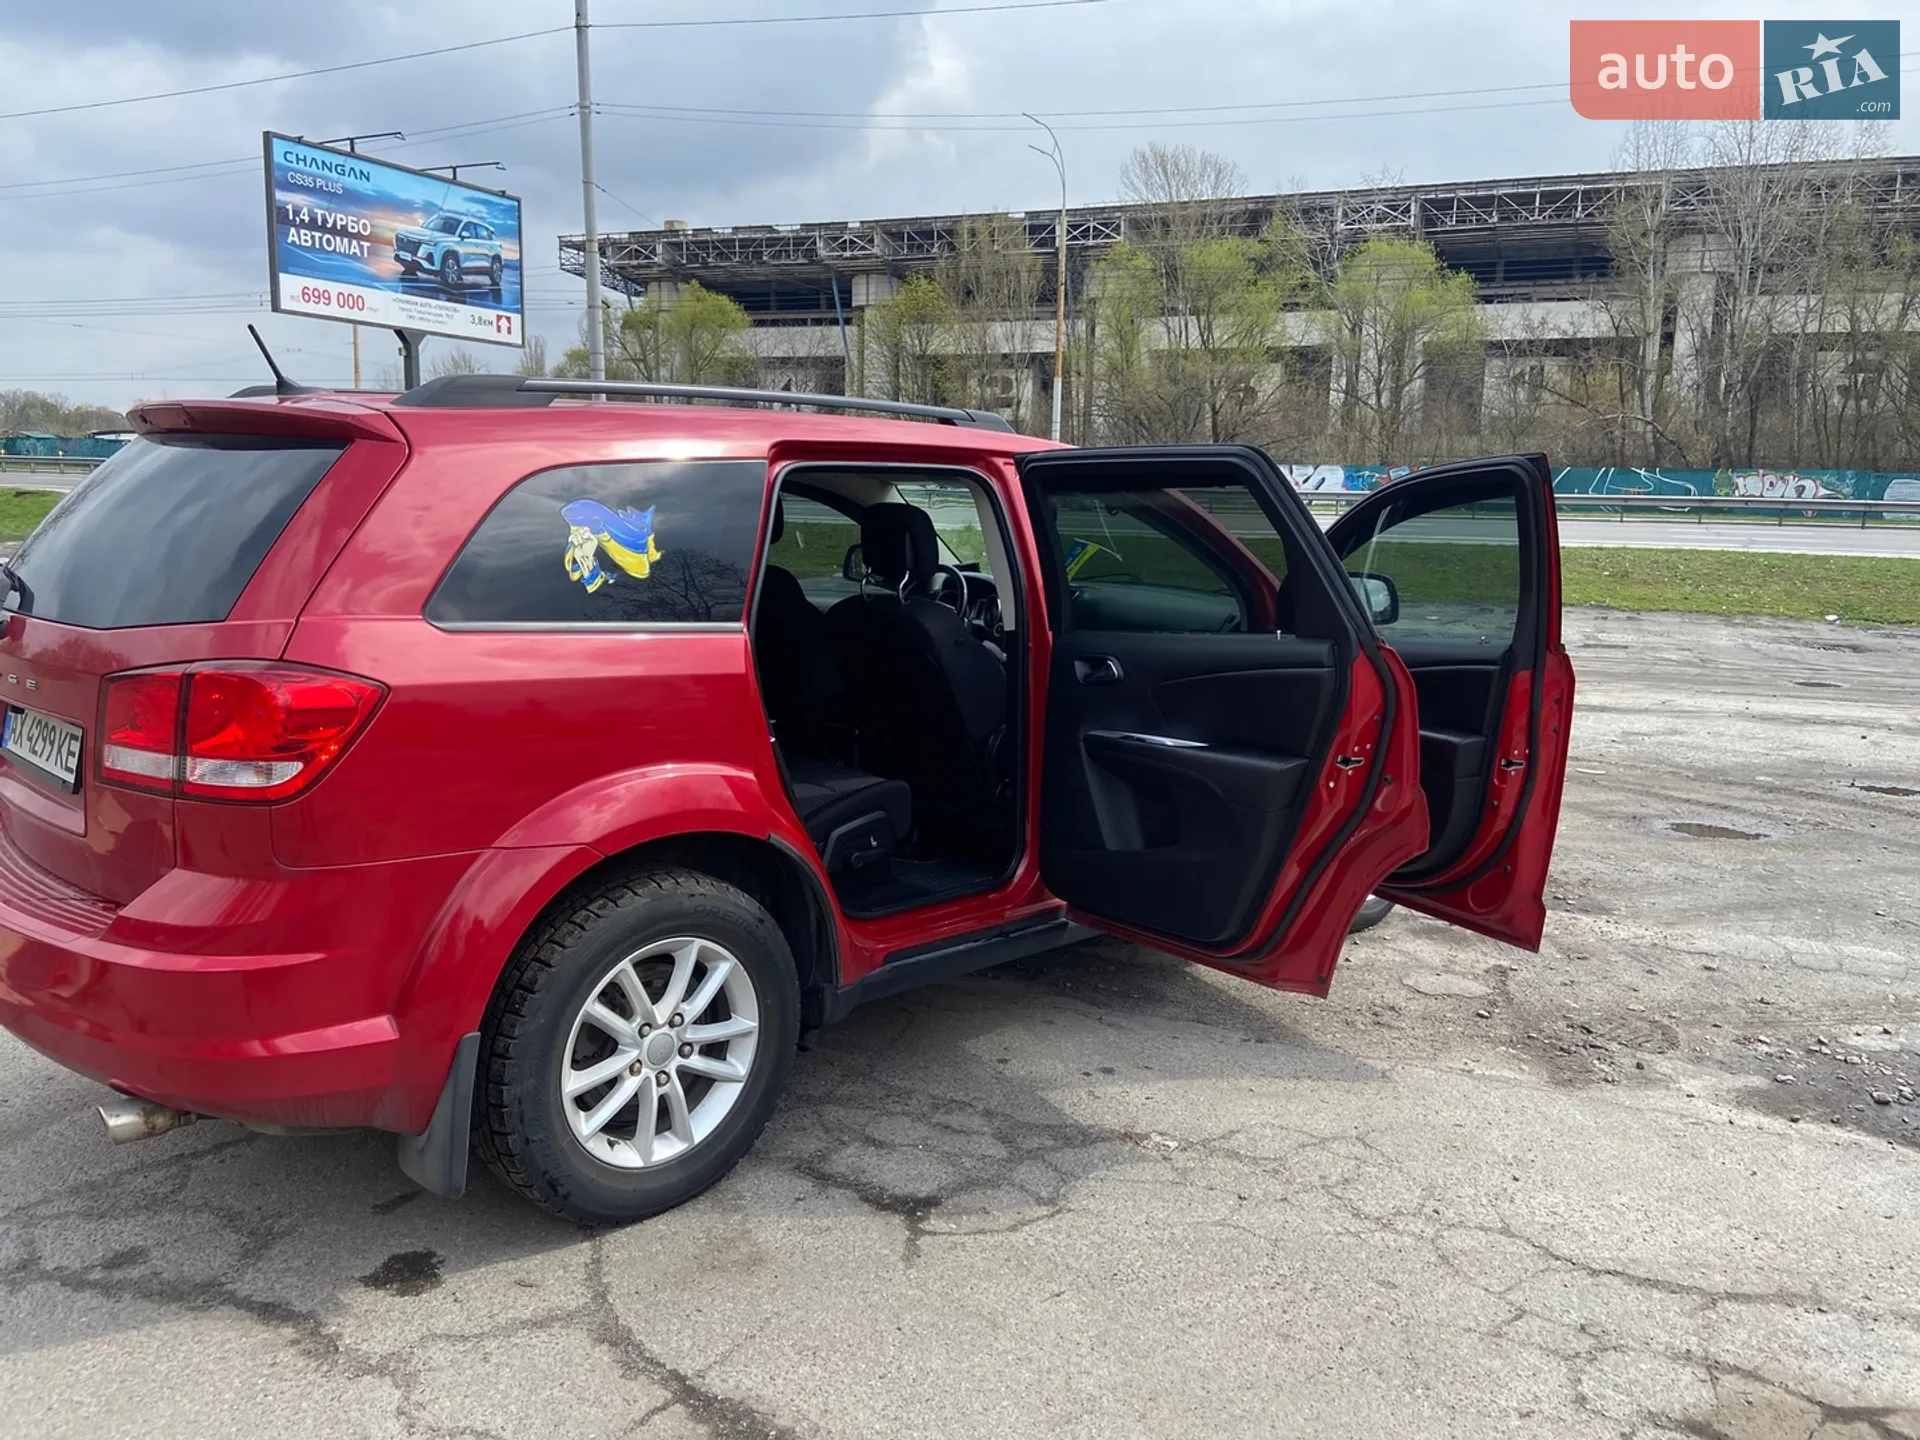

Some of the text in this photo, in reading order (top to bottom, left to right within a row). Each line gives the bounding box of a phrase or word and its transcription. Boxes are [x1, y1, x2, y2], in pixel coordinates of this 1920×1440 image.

[283, 150, 371, 182] CHANGAN
[287, 171, 343, 195] CS35 PLUS
[285, 203, 371, 236] 1,4 ТУРБО
[287, 227, 371, 258] АВТОМАТ
[301, 286, 332, 307] 699
[336, 291, 365, 312] 000
[27, 715, 56, 763] 4299
[54, 728, 80, 775] KE
